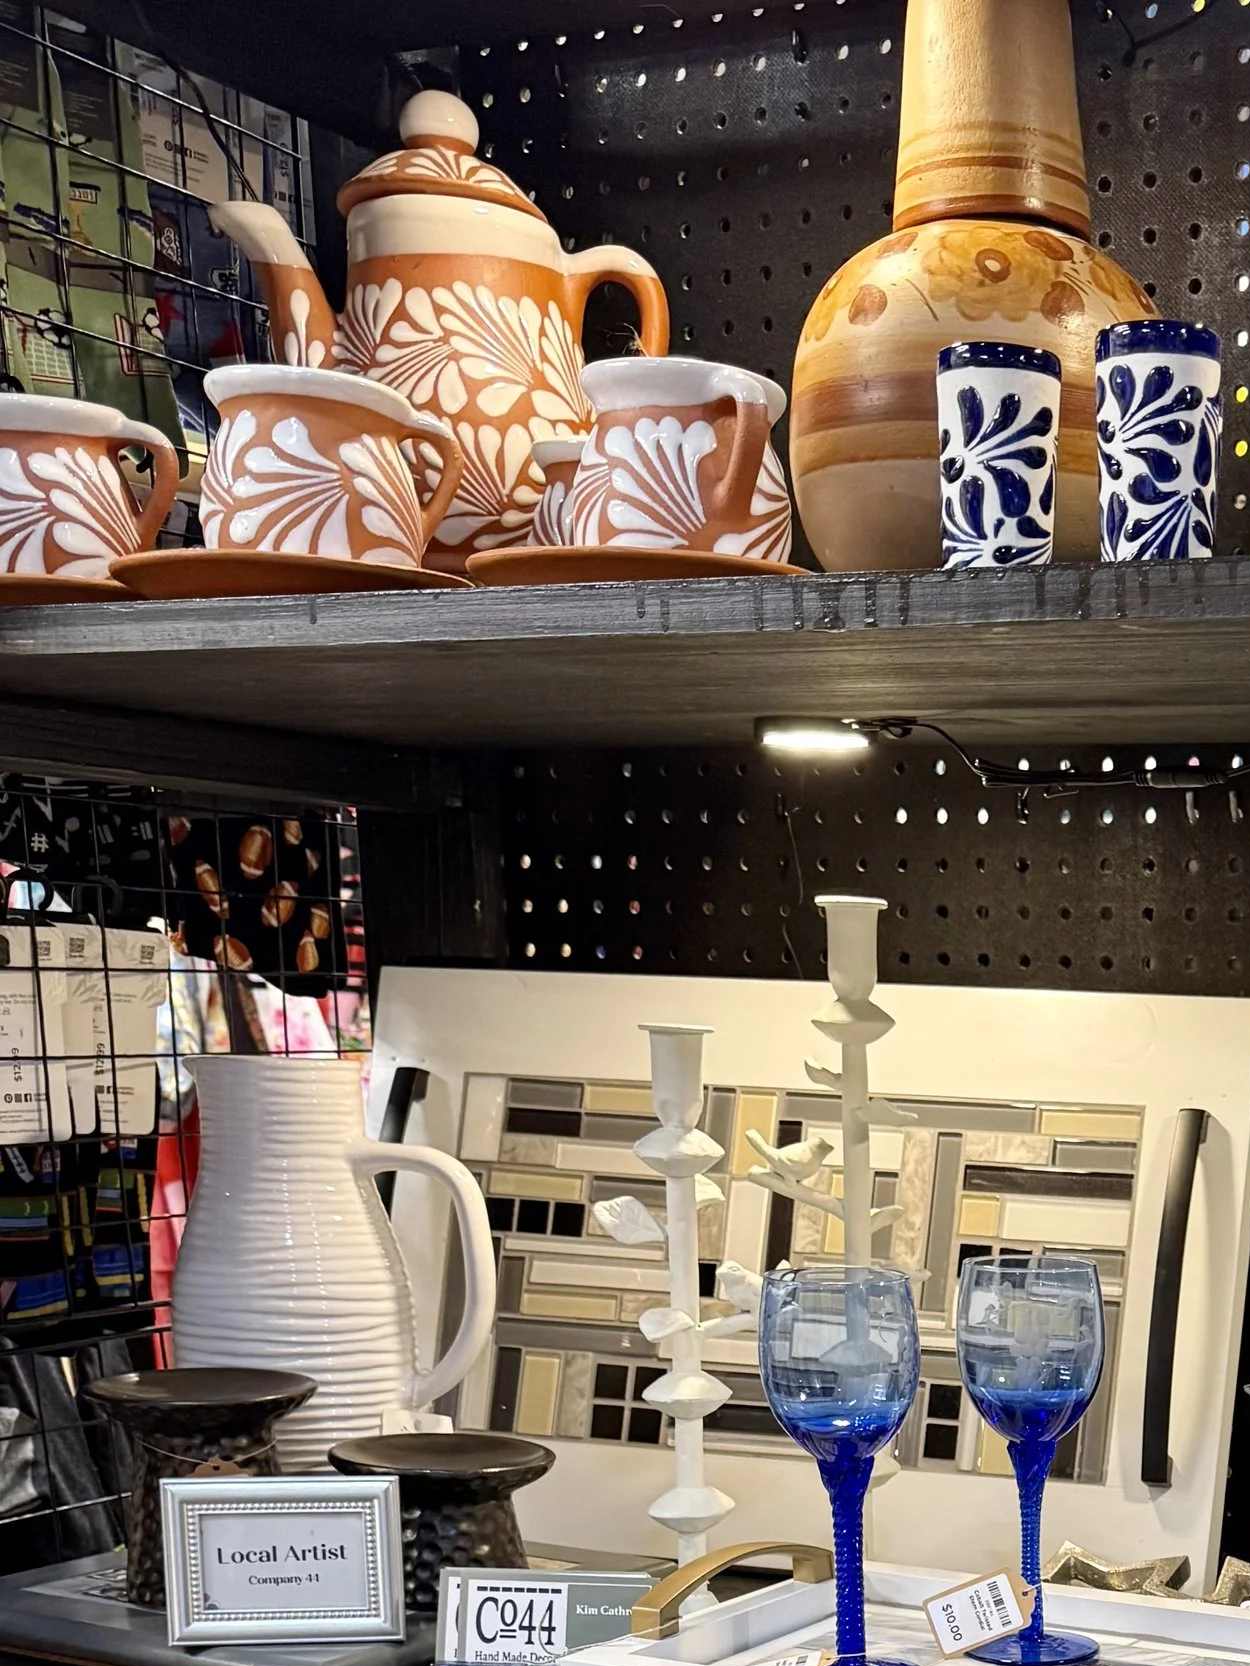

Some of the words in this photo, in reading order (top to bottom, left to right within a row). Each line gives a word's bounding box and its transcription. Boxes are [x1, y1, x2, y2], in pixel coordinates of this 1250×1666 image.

[11, 1047, 23, 1082] $12.9
[94, 1043, 105, 1076] $1299
[217, 1545, 277, 1565] Local
[284, 1543, 348, 1563] Artist
[249, 1574, 304, 1586] Company
[305, 1573, 320, 1583] 44
[576, 1604, 598, 1616] Kim
[942, 1603, 963, 1641] $10.00
[475, 1650, 500, 1662] Hand
[503, 1651, 527, 1663] Made
